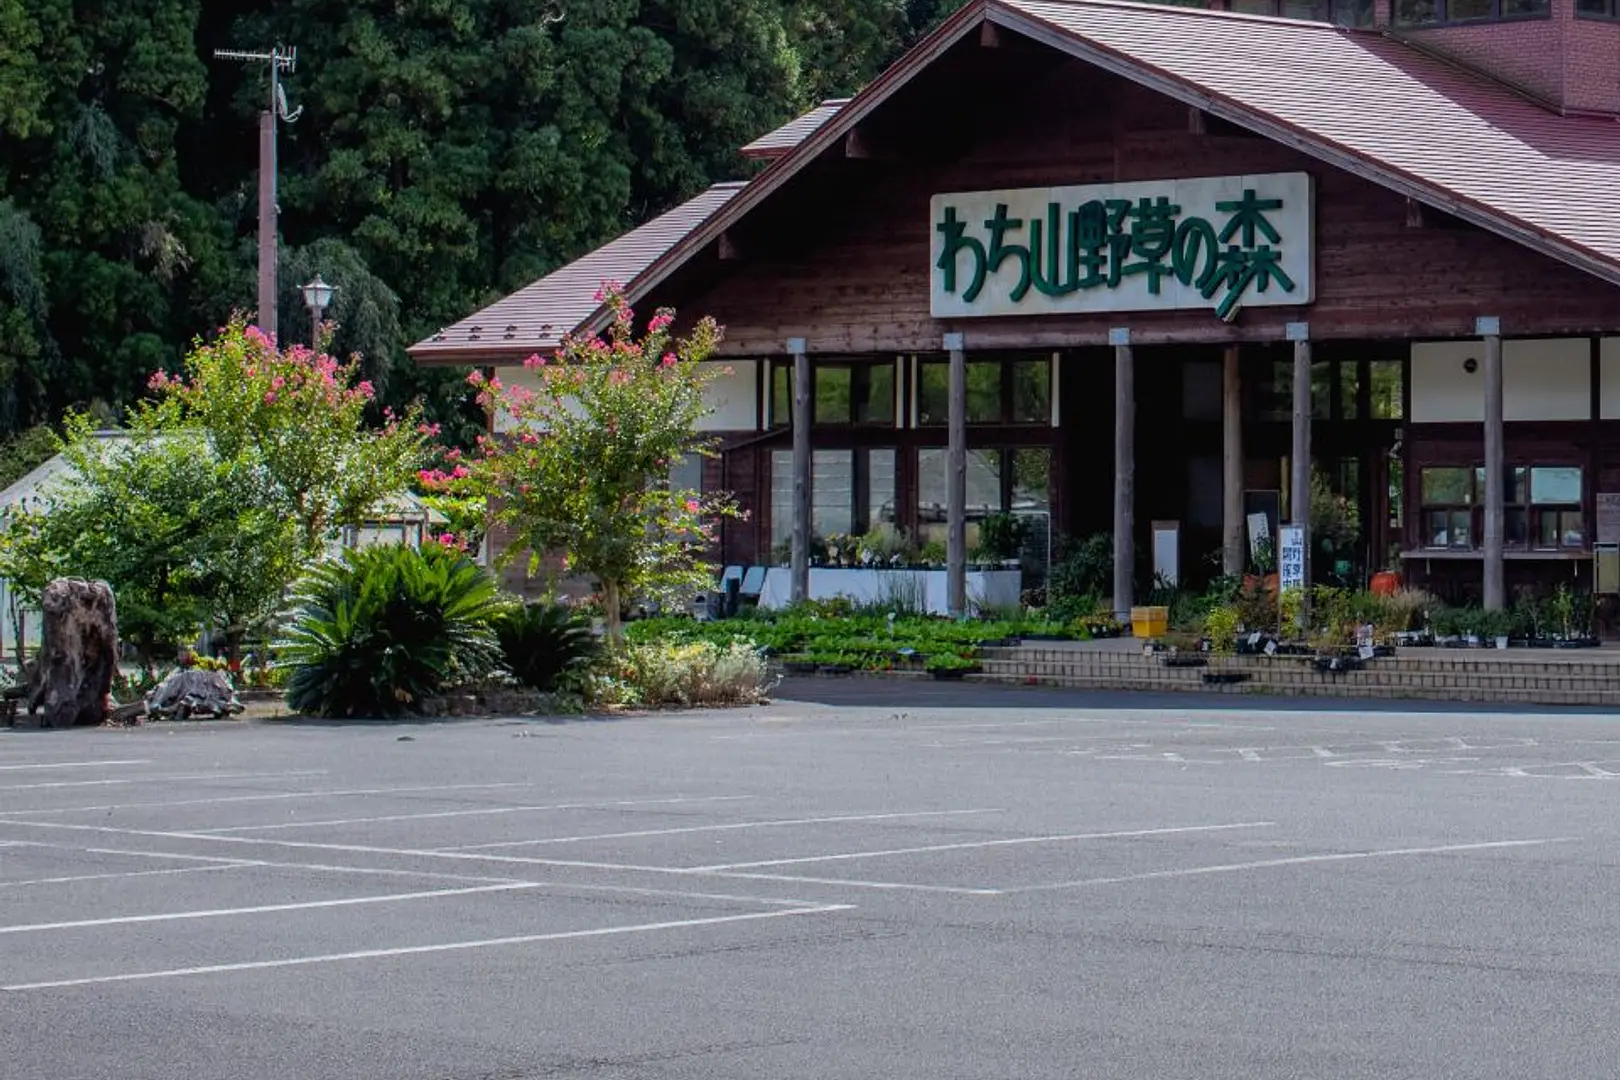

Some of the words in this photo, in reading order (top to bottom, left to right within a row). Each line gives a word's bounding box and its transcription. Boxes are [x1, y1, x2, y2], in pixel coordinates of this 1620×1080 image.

[936, 188, 1296, 318] わち山野草の森
